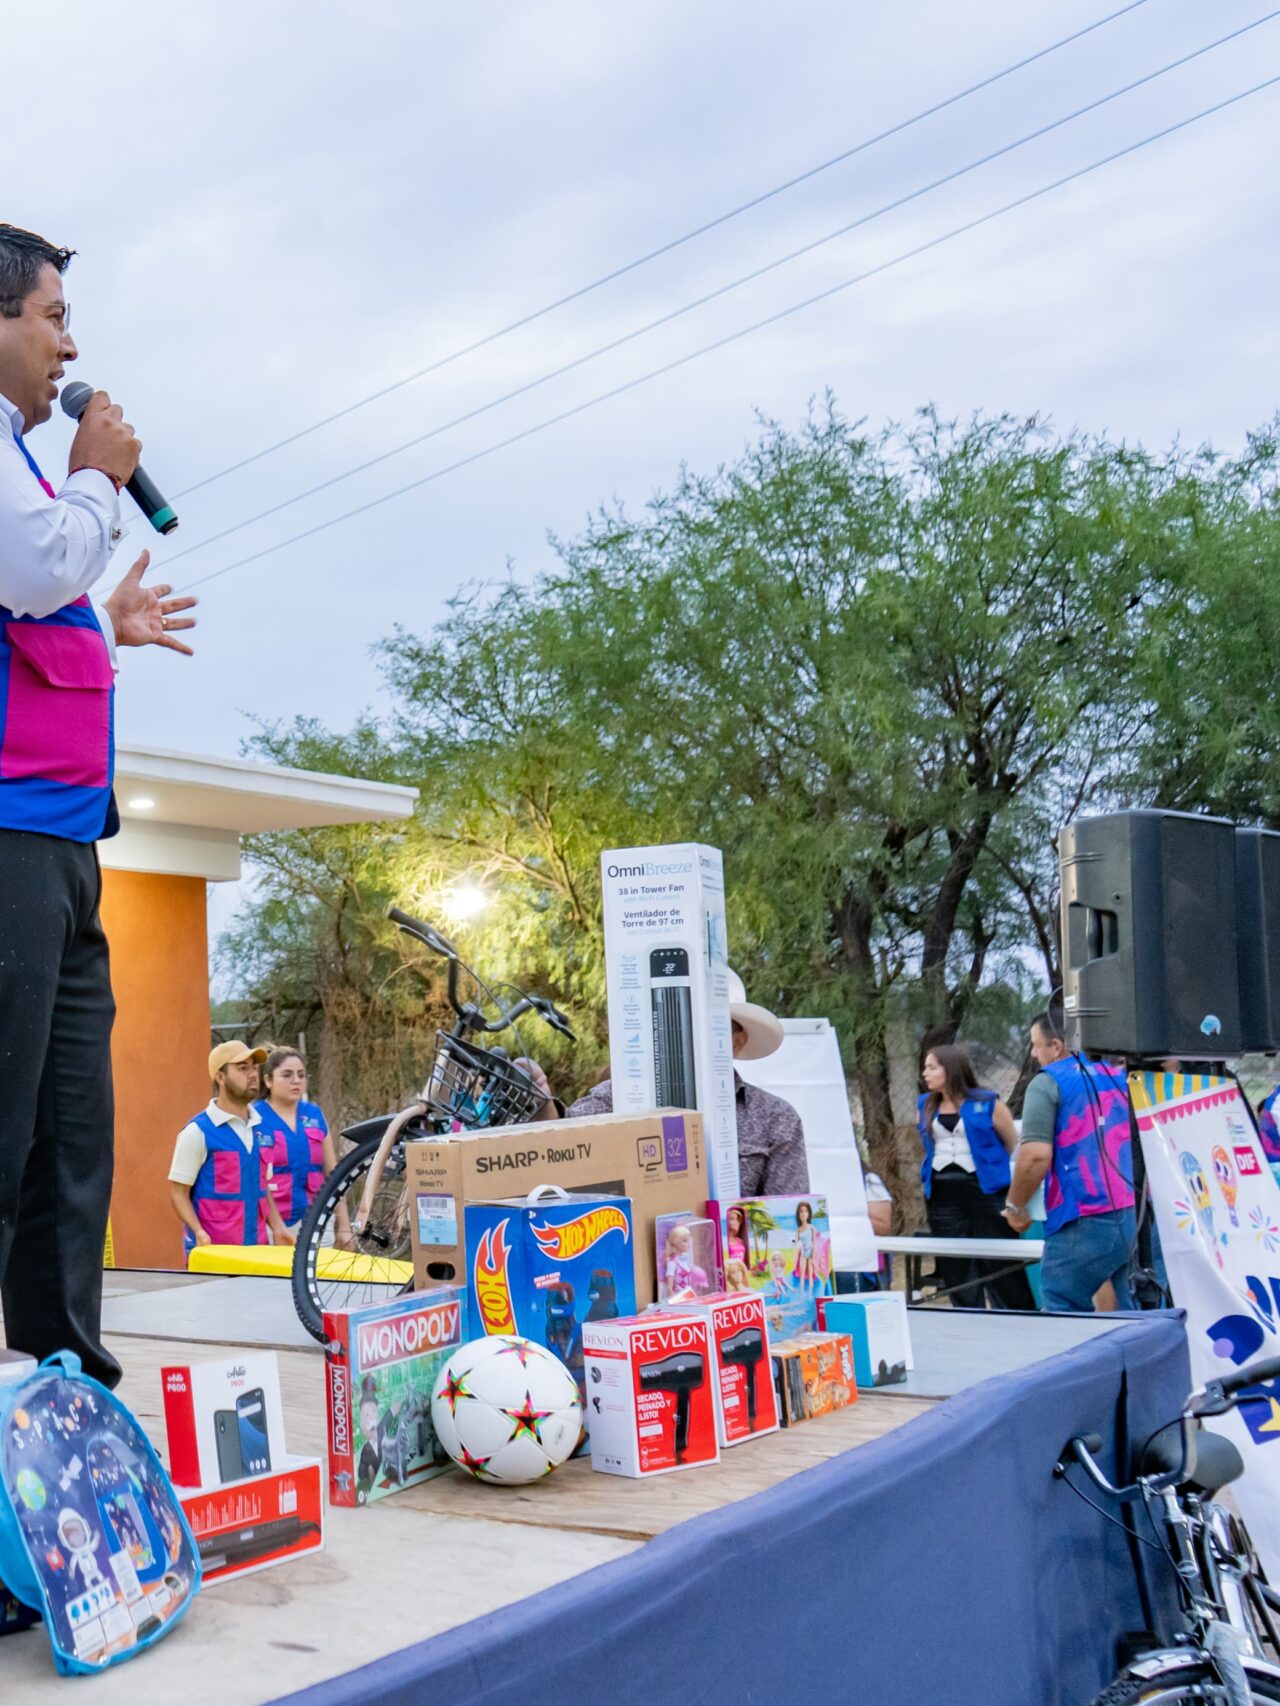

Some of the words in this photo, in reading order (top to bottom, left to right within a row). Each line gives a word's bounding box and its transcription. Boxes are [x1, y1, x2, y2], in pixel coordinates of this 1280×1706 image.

[607, 862, 692, 878] OmniBreeze
[630, 887, 638, 895] in
[641, 885, 667, 894] Tower
[668, 884, 684, 892] Fan
[623, 909, 667, 919] Ventilador
[669, 908, 680, 916] de
[622, 920, 645, 928] Torre
[646, 919, 657, 927] de
[658, 918, 668, 926] 97
[476, 1151, 538, 1173] SHARP
[577, 1143, 591, 1160] TV
[642, 1144, 657, 1158] HD
[1235, 1152, 1255, 1171] DIF
[415, 1168, 447, 1176] SHARP
[555, 1224, 585, 1257] HOT
[713, 1301, 763, 1330] REVLON
[361, 1307, 459, 1364] MONOPOLY
[584, 1334, 624, 1347] REVLON
[631, 1324, 707, 1354] REVLON
[166, 1383, 187, 1393] P600
[332, 1368, 348, 1454] MONOPOLY
[666, 1399, 671, 1408] Y
